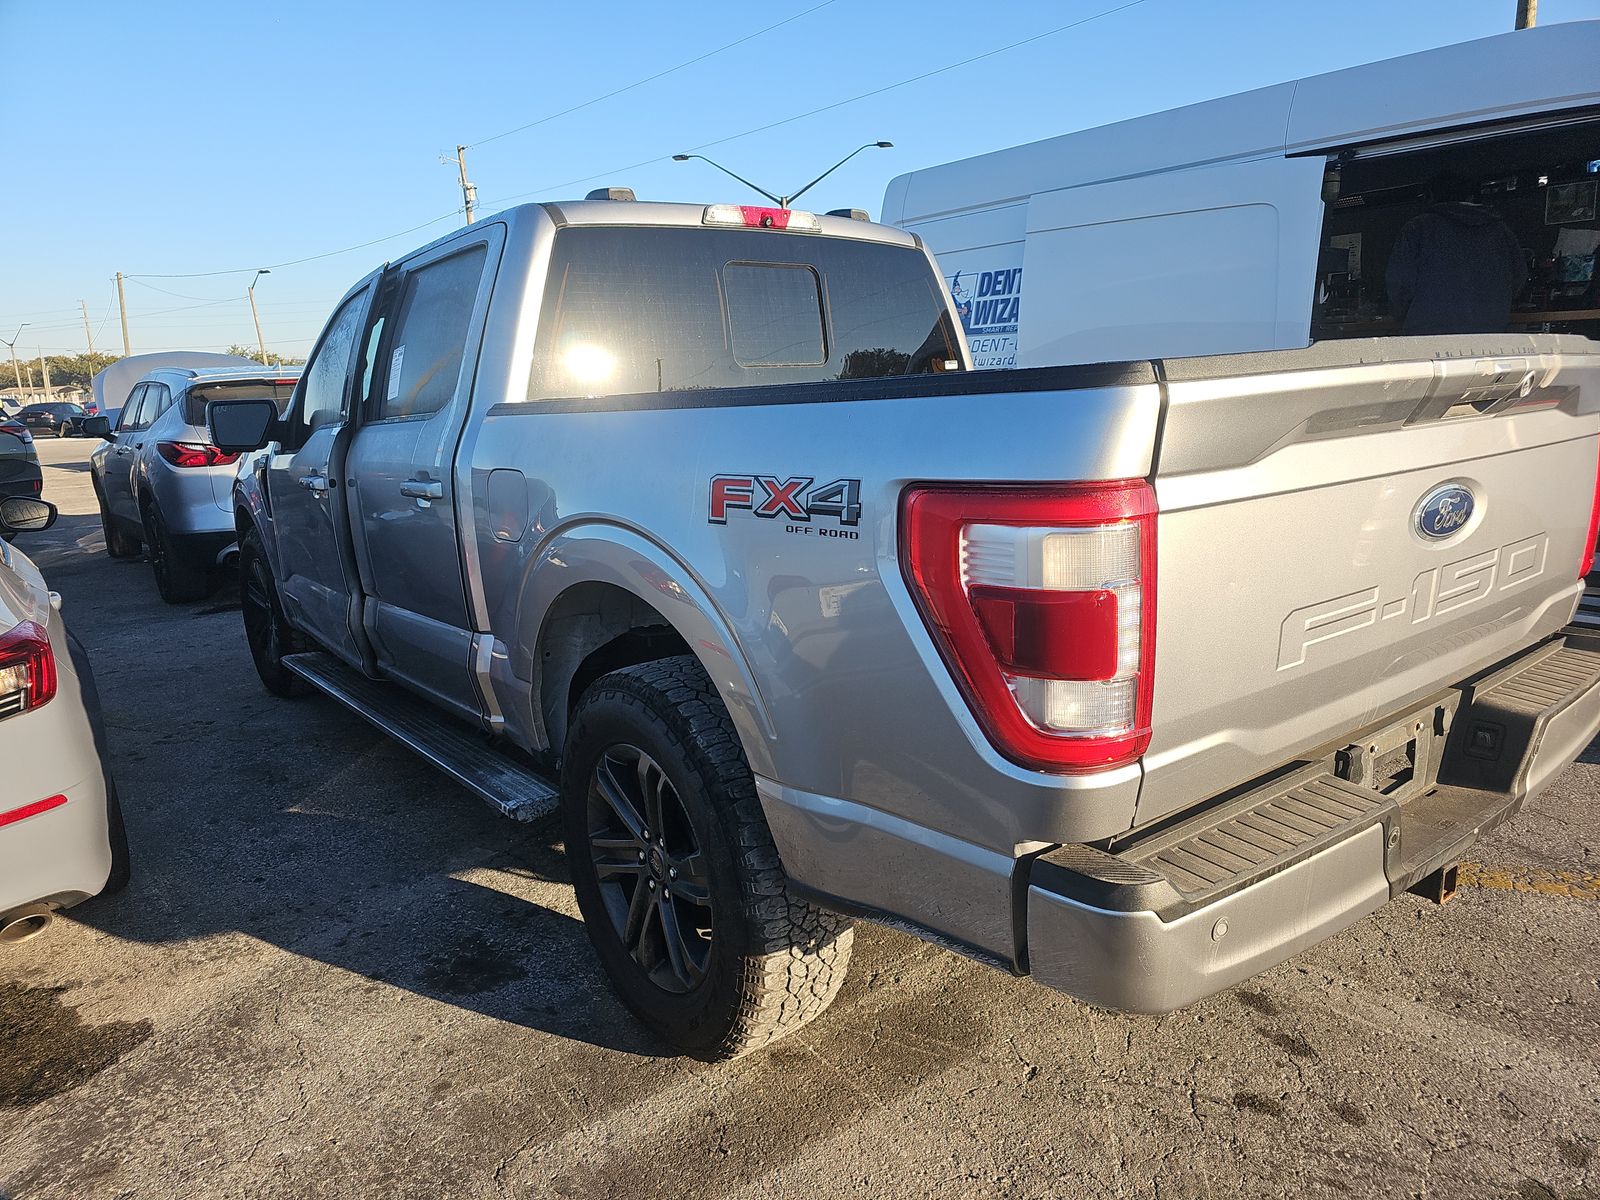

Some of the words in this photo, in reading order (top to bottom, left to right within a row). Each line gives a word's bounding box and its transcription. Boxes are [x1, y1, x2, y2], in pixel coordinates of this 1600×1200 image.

[977, 267, 1023, 298] DENT
[982, 325, 1004, 334] SMART
[708, 473, 862, 526] FX4
[1434, 496, 1468, 531] Ford
[785, 525, 813, 535] OFF
[819, 528, 859, 540] ROAD
[1276, 531, 1549, 672] F-150
